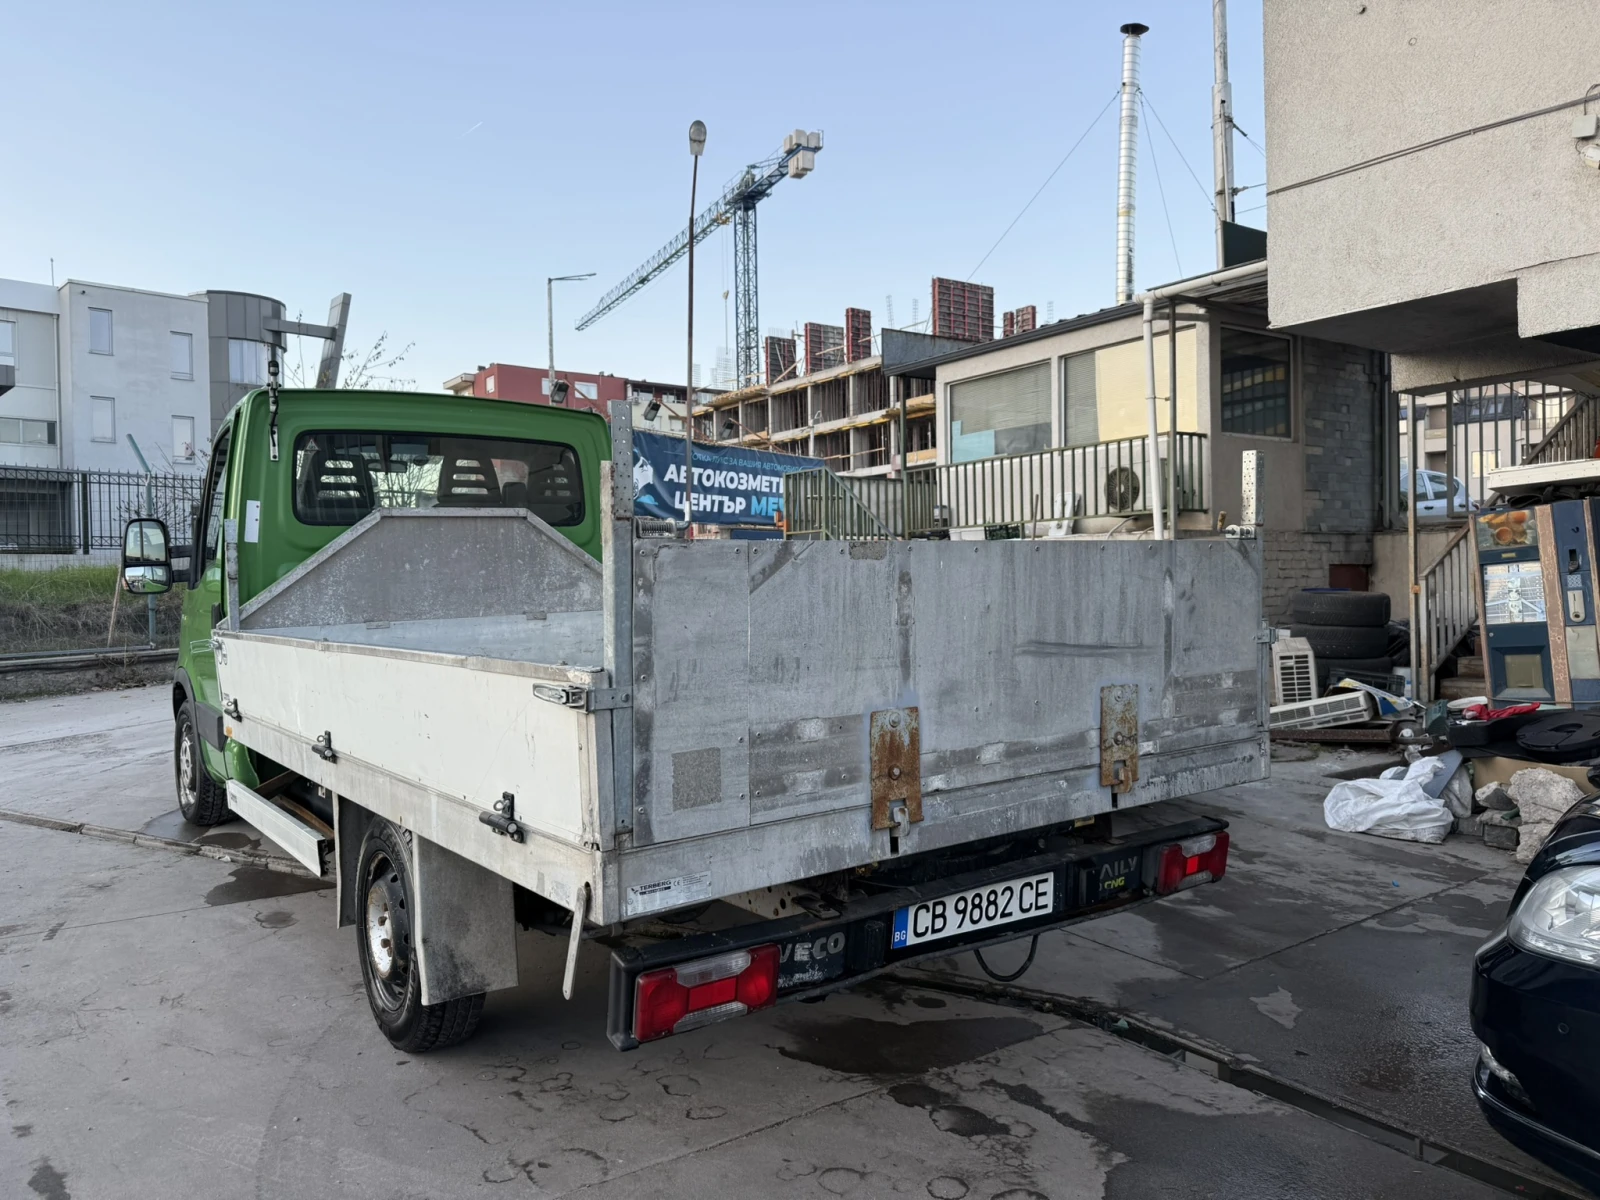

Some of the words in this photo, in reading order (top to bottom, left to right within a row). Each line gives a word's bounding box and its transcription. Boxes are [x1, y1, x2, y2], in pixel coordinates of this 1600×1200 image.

[674, 491, 746, 514] ЦЕНТЪР
[1099, 856, 1138, 880] AILY
[639, 880, 671, 892] TERBERG
[1104, 876, 1125, 889] CNG
[913, 900, 947, 938] CB
[954, 886, 1014, 929] 9882
[1018, 878, 1049, 913] CE
[777, 932, 846, 963] VECO
[894, 930, 906, 942] BG
